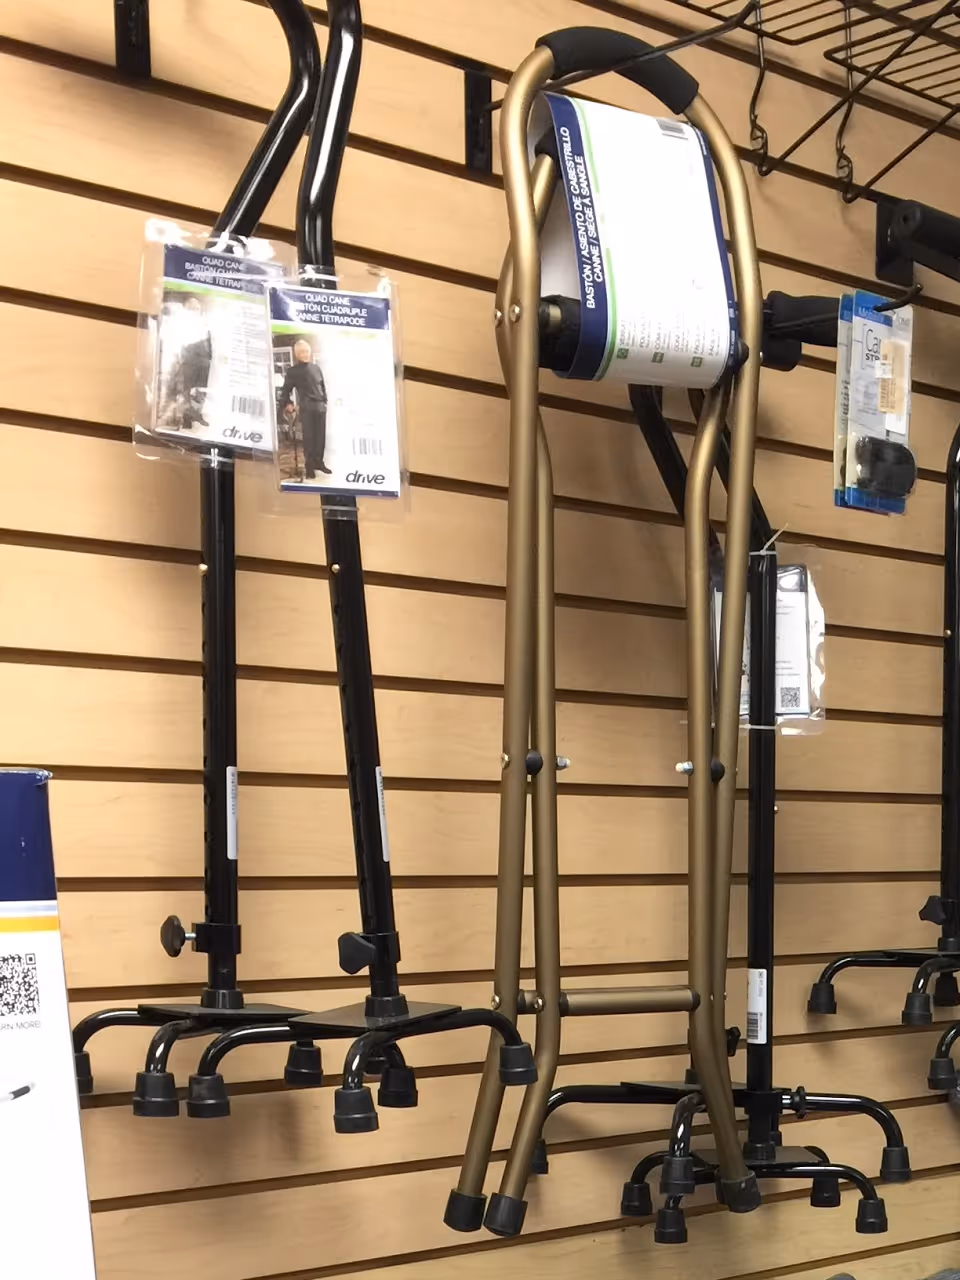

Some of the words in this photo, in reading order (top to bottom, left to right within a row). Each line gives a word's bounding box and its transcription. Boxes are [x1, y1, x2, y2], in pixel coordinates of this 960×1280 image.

[560, 127, 580, 194] CABESTRILLO
[575, 156, 589, 196] SANGLE
[573, 195, 583, 212] DE
[575, 212, 589, 257] ASIENTO
[590, 245, 603, 282] CANNE
[306, 293, 327, 304] QUAD
[329, 295, 350, 305] CANE
[222, 425, 263, 444] drive
[345, 470, 385, 485] drive
